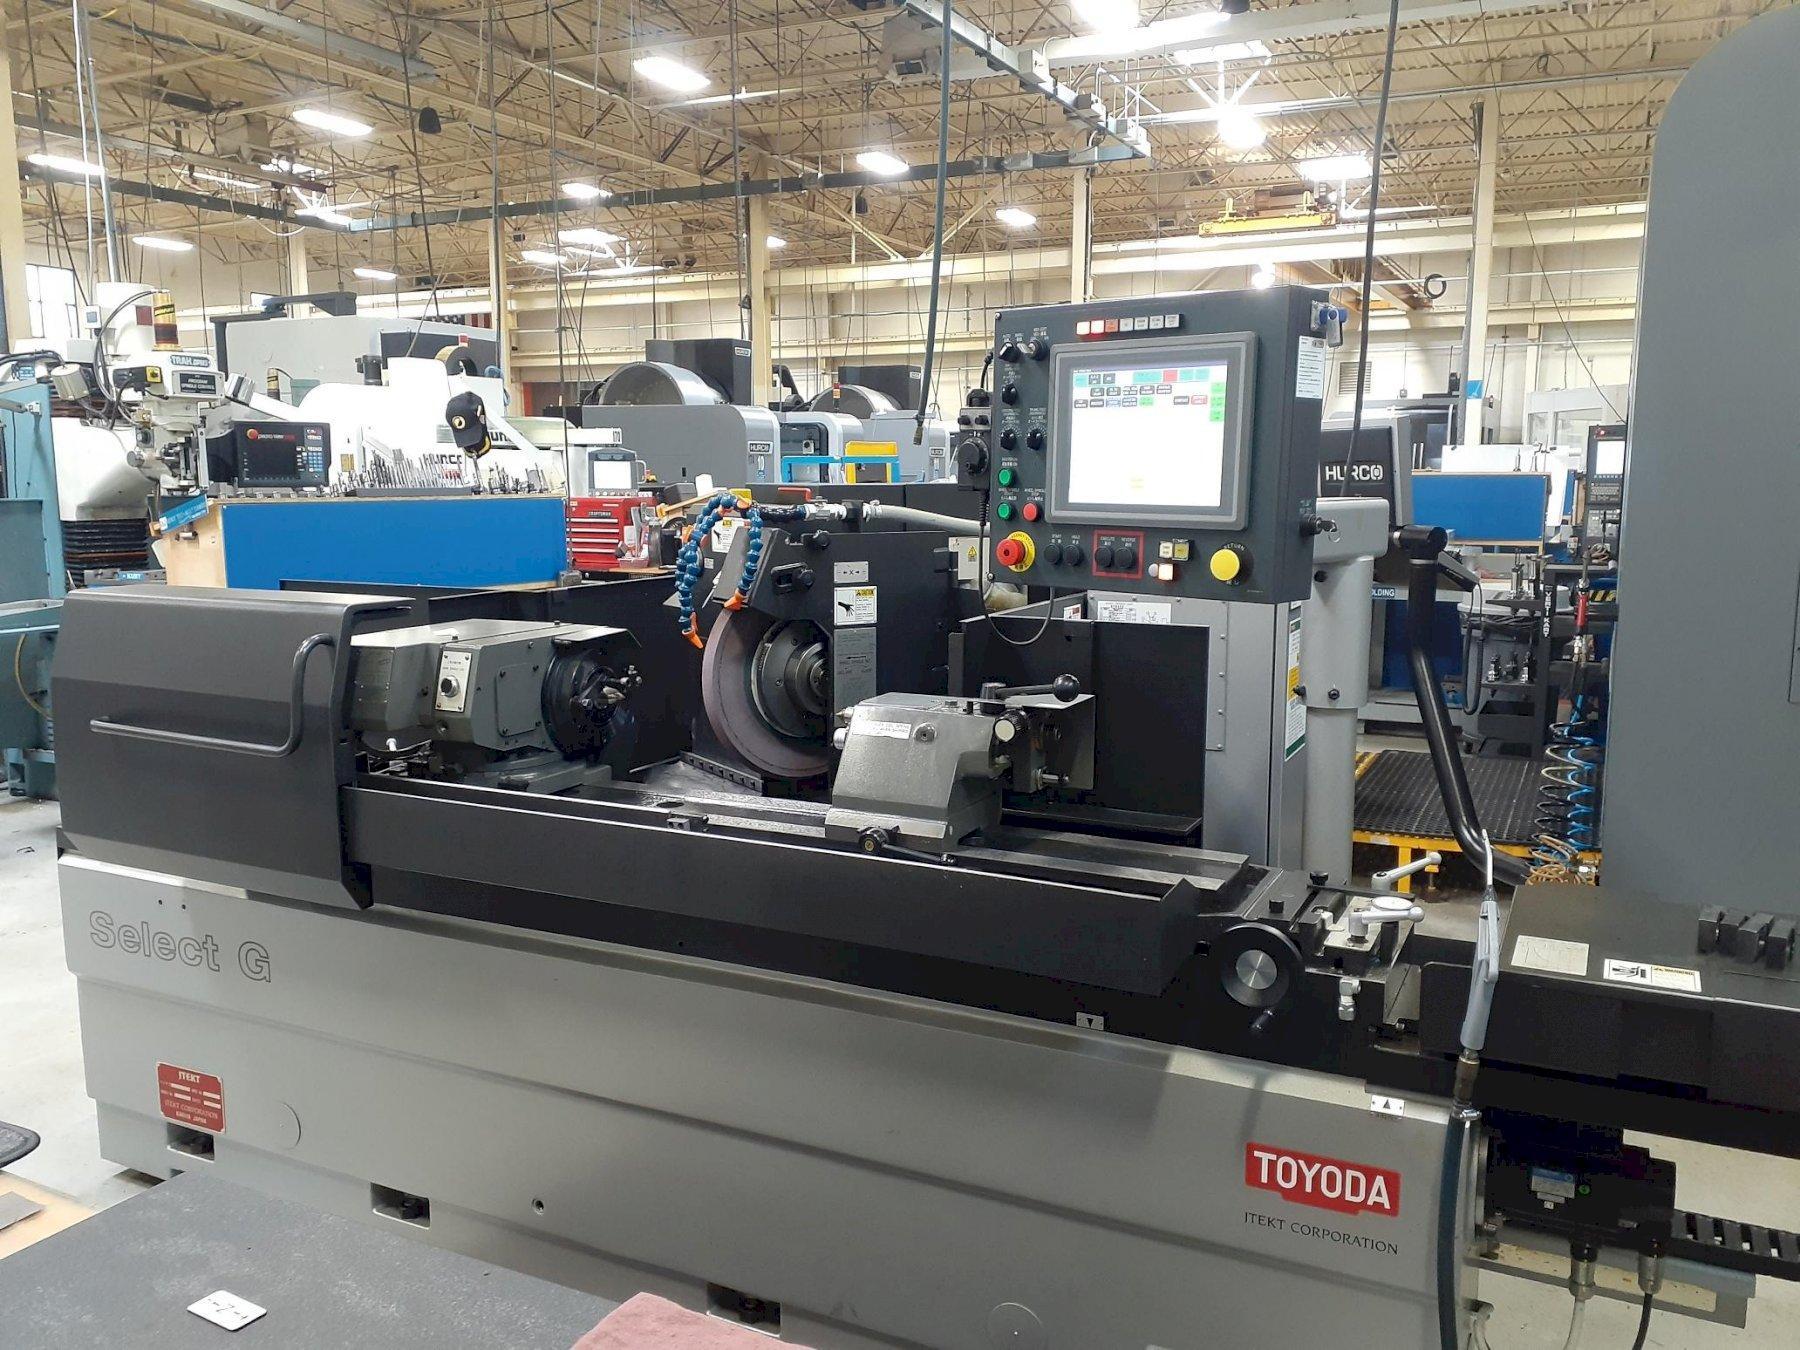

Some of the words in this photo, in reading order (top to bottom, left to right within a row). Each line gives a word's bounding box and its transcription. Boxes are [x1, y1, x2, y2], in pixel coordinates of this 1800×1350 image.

[1325, 464, 1384, 481] HURCO
[89, 910, 221, 972] Select
[238, 941, 272, 983] G
[1253, 1150, 1392, 1210] TOYODA
[1244, 1212, 1287, 1231] JTEKT
[1290, 1222, 1399, 1256] CORPORATION
